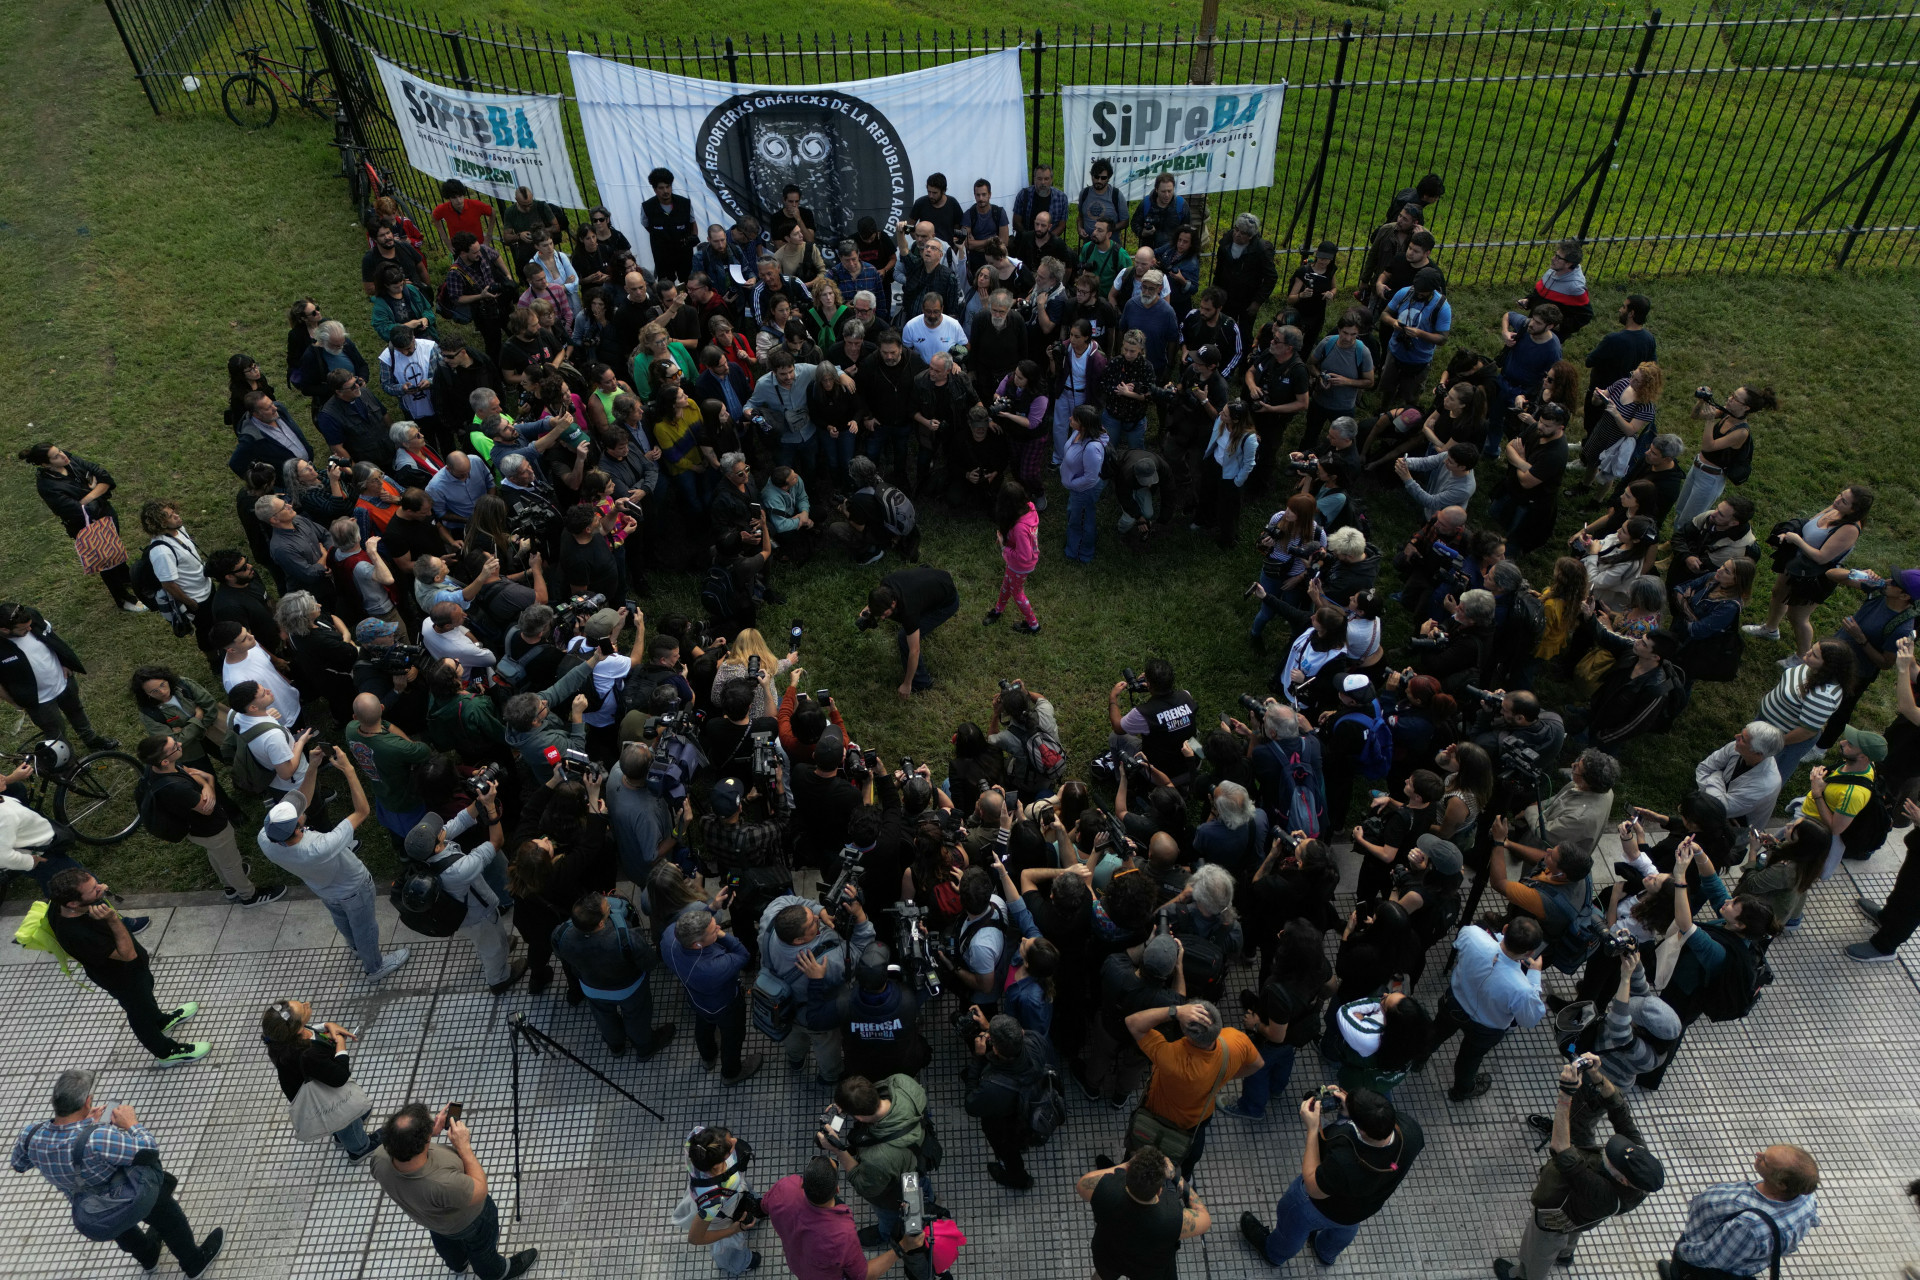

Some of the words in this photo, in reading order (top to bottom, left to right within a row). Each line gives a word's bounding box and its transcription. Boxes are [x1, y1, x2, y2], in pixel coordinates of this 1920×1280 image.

[401, 80, 537, 149] SiPreBA
[705, 101, 753, 170] REPORTERXS
[755, 94, 828, 108] GRÁFICXS
[830, 99, 850, 114] DE
[850, 107, 869, 126] LA
[866, 121, 904, 194] REPÚBLICA
[453, 157, 513, 184] FATPREN
[1156, 703, 1193, 725] PRENSA
[851, 1018, 902, 1033] PRENSA
